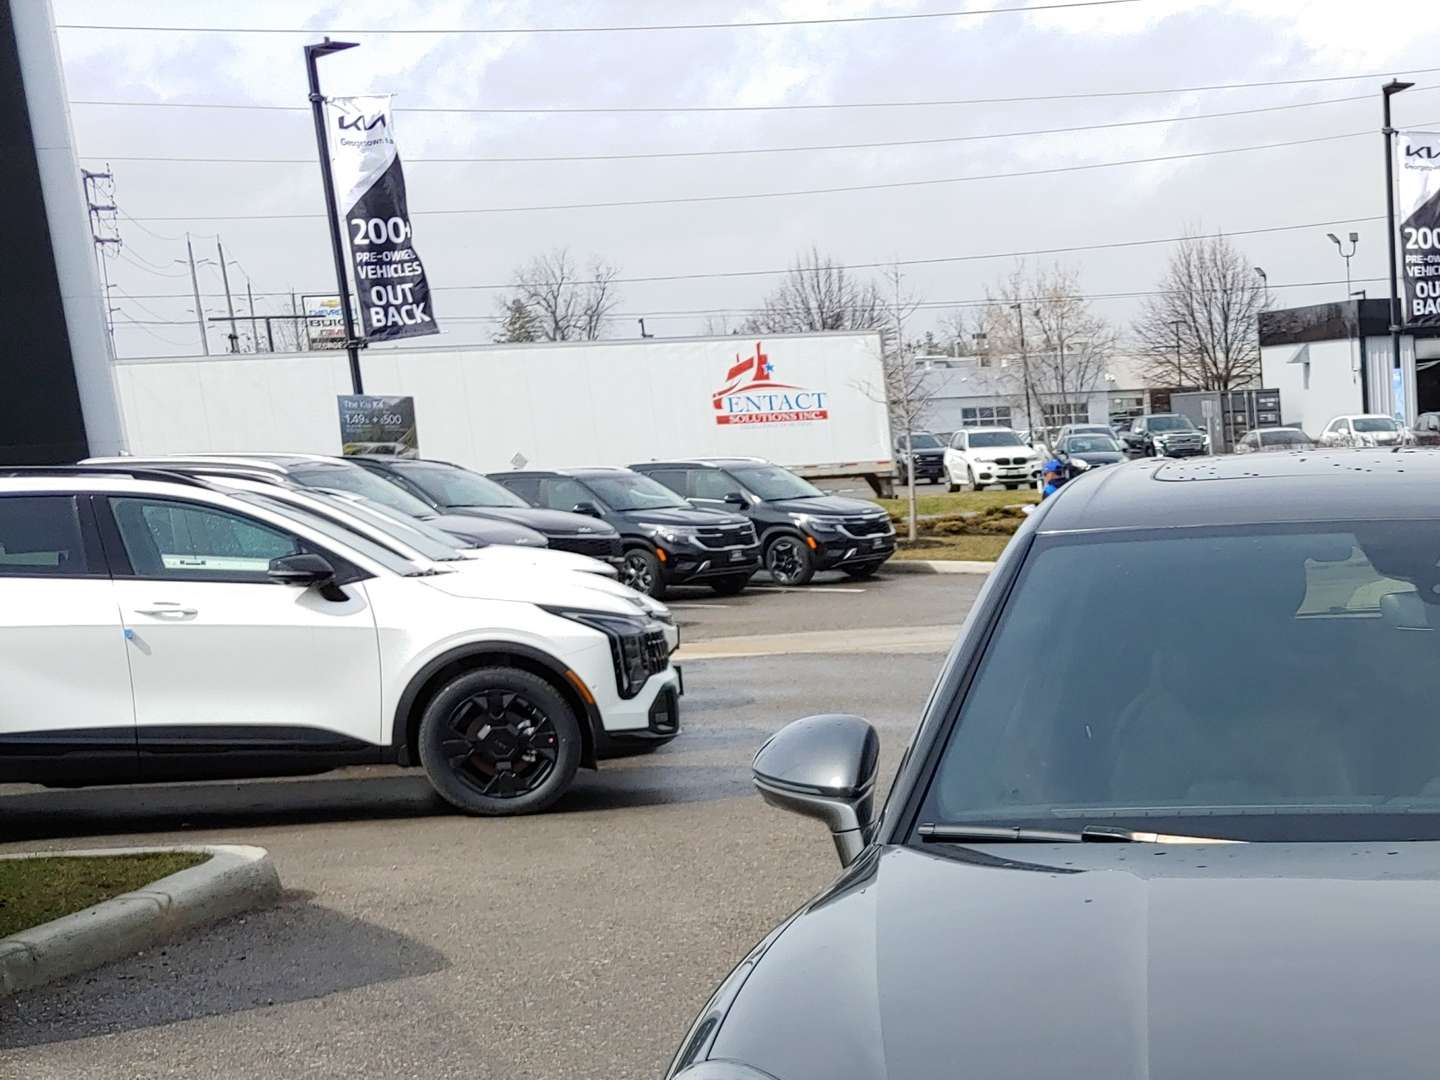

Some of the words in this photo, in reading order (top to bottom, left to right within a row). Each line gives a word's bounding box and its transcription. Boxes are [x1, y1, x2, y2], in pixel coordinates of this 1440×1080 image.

[338, 113, 387, 131] KIA
[357, 262, 422, 280] VEHICLES
[371, 283, 415, 306] OUT
[370, 303, 431, 328] BACK
[728, 412, 798, 425] SOLUTIONS
